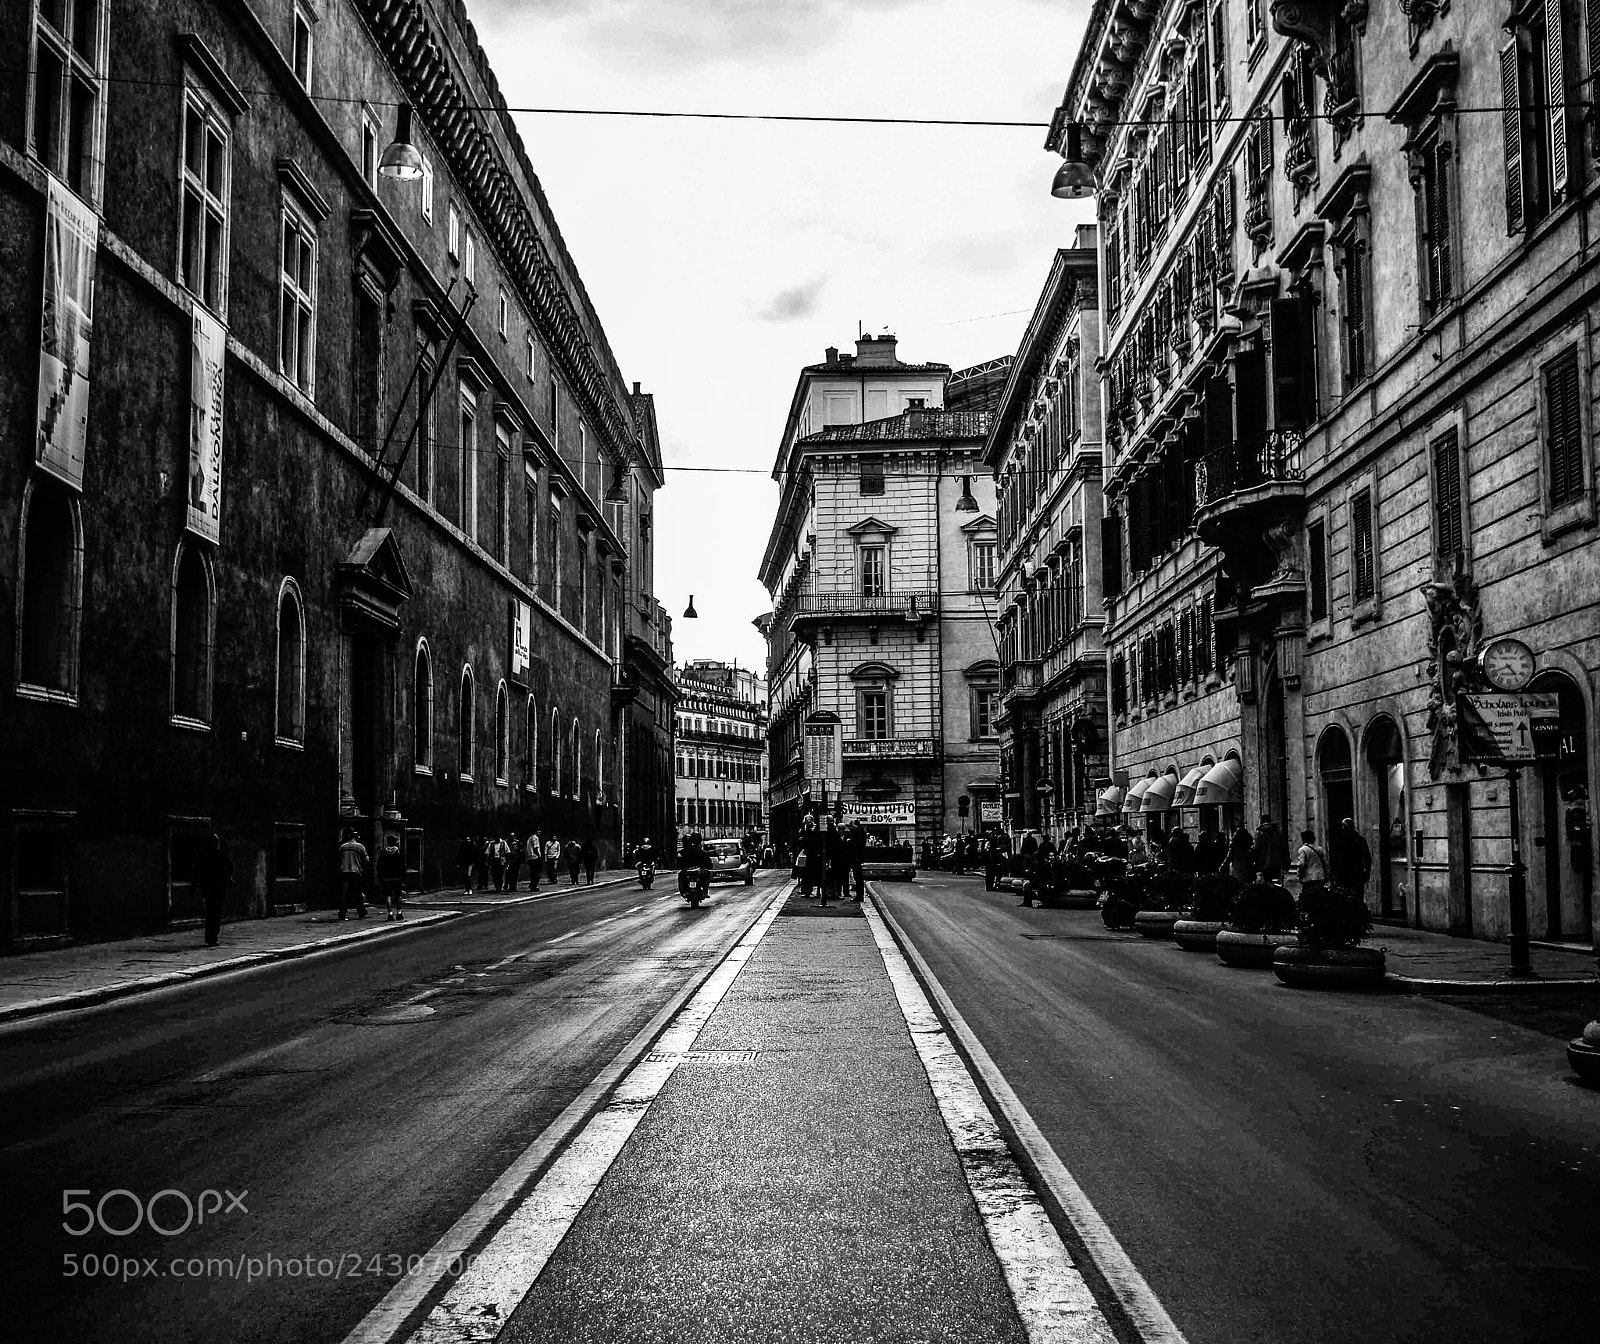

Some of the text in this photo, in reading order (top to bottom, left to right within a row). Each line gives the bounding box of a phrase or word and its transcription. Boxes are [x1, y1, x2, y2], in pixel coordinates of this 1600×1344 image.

[211, 366, 224, 522] DALL'OMBRA
[1471, 696, 1517, 709] Scholars
[841, 802, 915, 815] SVUOTA TUTTO
